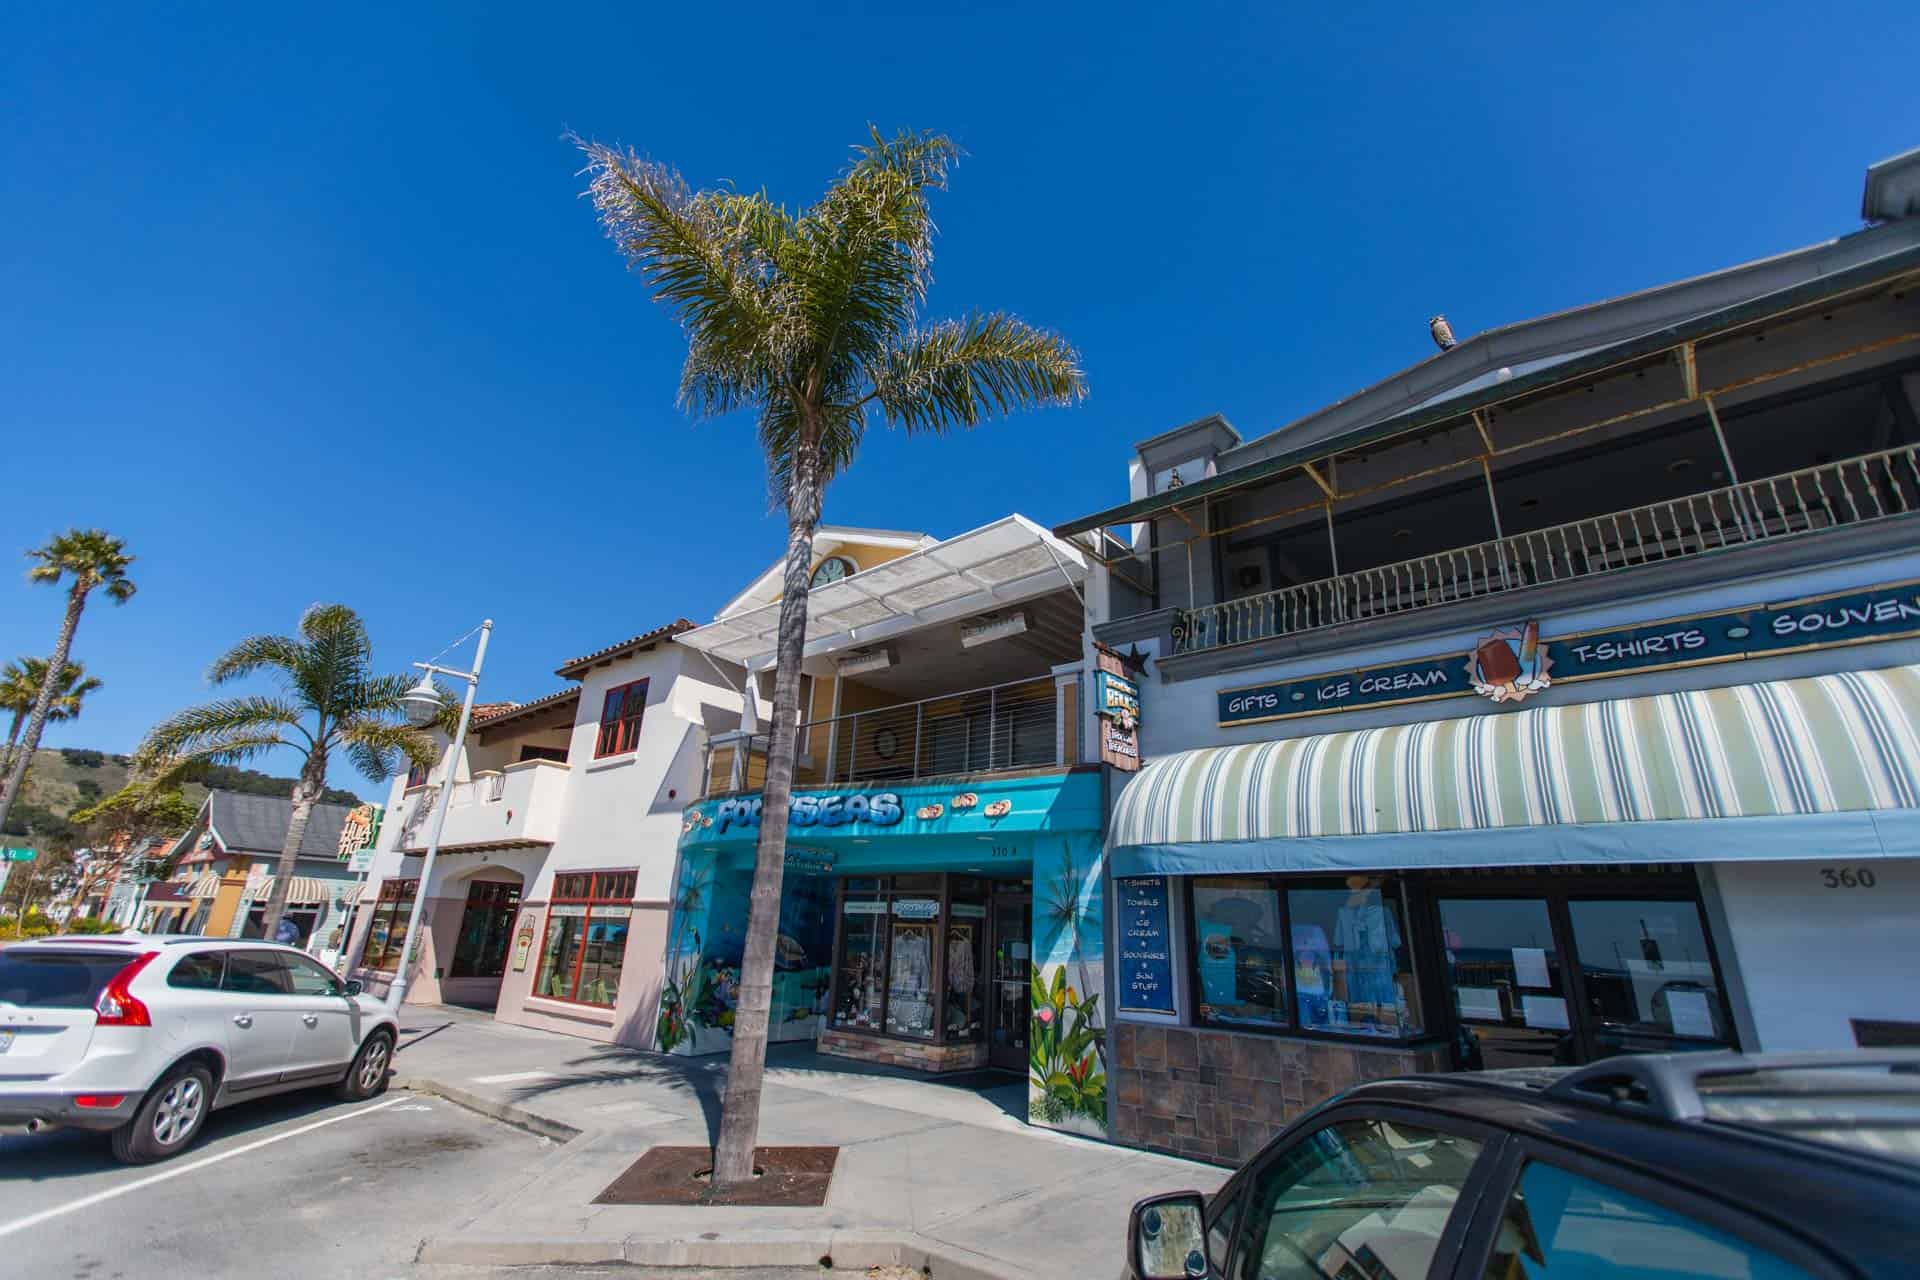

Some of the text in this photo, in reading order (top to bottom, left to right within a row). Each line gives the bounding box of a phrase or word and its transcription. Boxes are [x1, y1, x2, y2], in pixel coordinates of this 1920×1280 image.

[1571, 629, 1707, 664] T-SHIRTS
[1228, 669, 1448, 714] GIFTS ICE CREAM
[717, 793, 903, 833] FOOSEAS
[1820, 867, 1876, 889] 360
[1127, 898, 1159, 906] TOWELS
[1135, 919, 1151, 927] ICE
[1127, 928, 1159, 937] CREAM
[1131, 982, 1159, 991] STUFF
